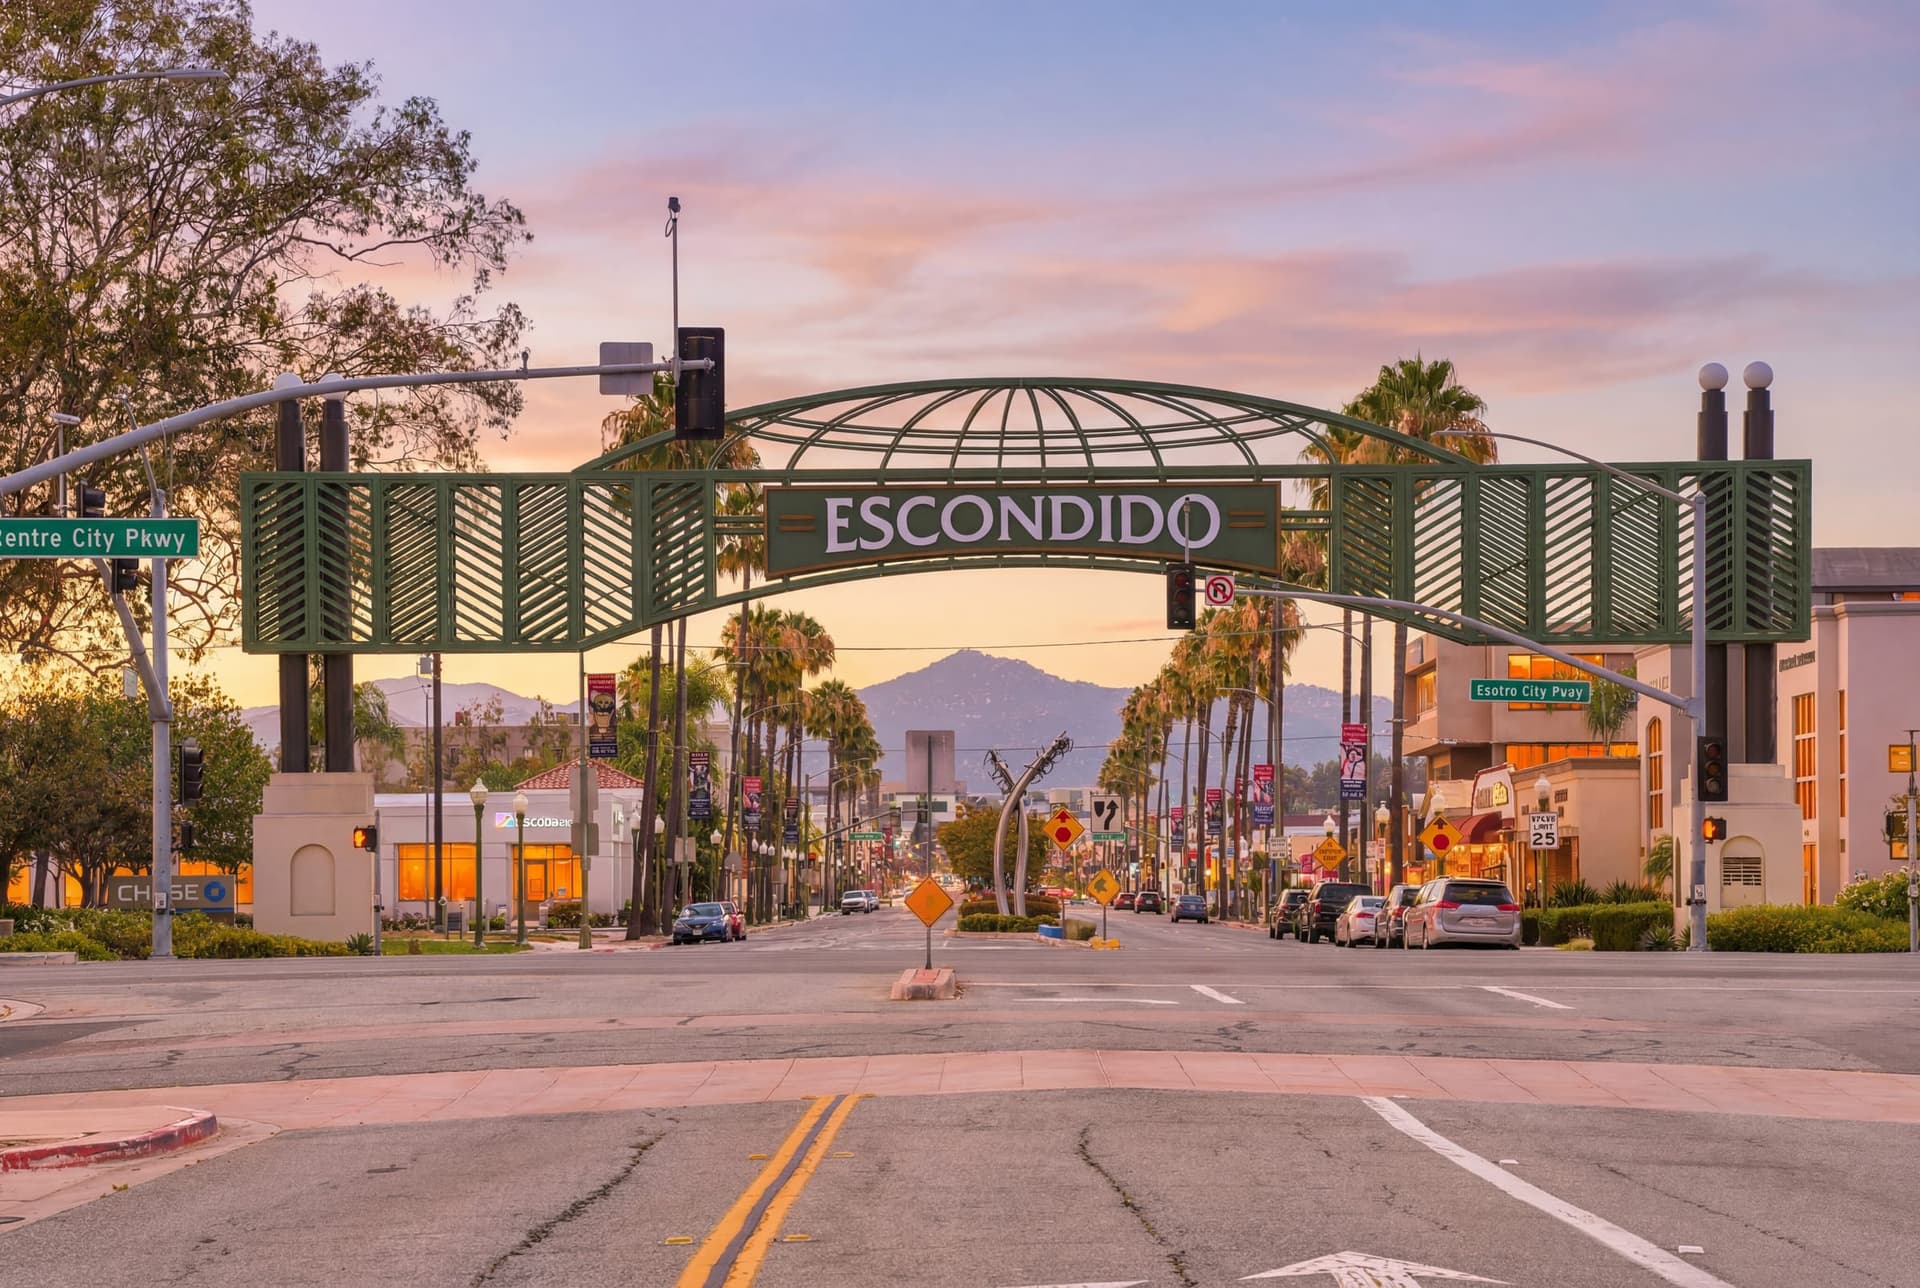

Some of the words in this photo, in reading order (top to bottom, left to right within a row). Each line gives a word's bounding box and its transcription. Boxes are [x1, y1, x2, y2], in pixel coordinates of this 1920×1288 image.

[824, 493, 1221, 554] ESCONDIDO
[72, 528, 115, 553] City
[125, 528, 186, 554] Pkwy
[1522, 685, 1547, 700] City
[1533, 832, 1555, 846] 25
[118, 884, 199, 901] CHSE
